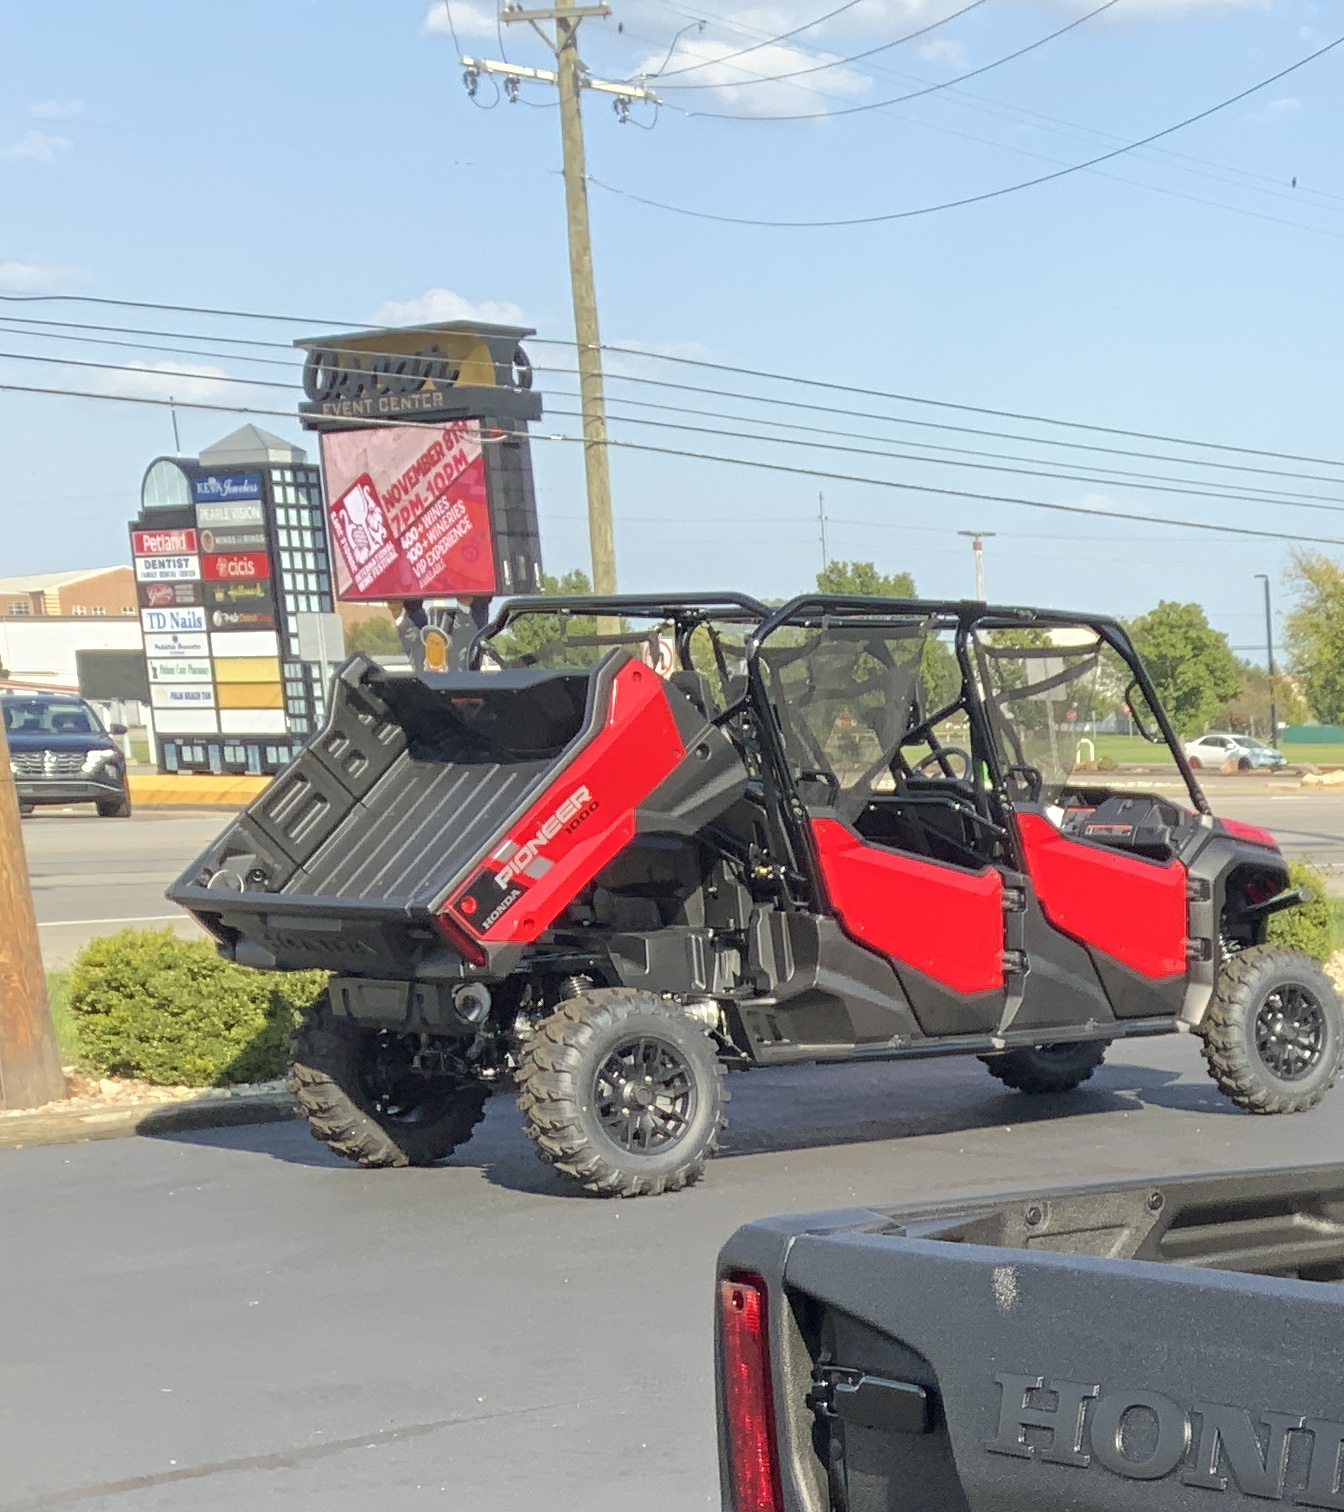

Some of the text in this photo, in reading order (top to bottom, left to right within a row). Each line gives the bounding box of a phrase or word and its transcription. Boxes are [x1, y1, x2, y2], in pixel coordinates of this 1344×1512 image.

[322, 391, 444, 416] EVENT CENTER
[381, 439, 446, 513] NOVEMBER
[200, 506, 260, 521] PEARLE VISION
[400, 496, 450, 549] 400+ WINES
[426, 500, 466, 544] WINERIES
[142, 533, 187, 552] Petland
[412, 516, 473, 578] VIP EXPERIENCE
[144, 558, 190, 571] DENTIST
[228, 557, 255, 576] cicis
[146, 612, 166, 630] TD
[170, 610, 203, 630] Nails
[563, 800, 600, 835] 1000
[494, 784, 593, 890] PIONEER
[481, 889, 522, 931] HONDA
